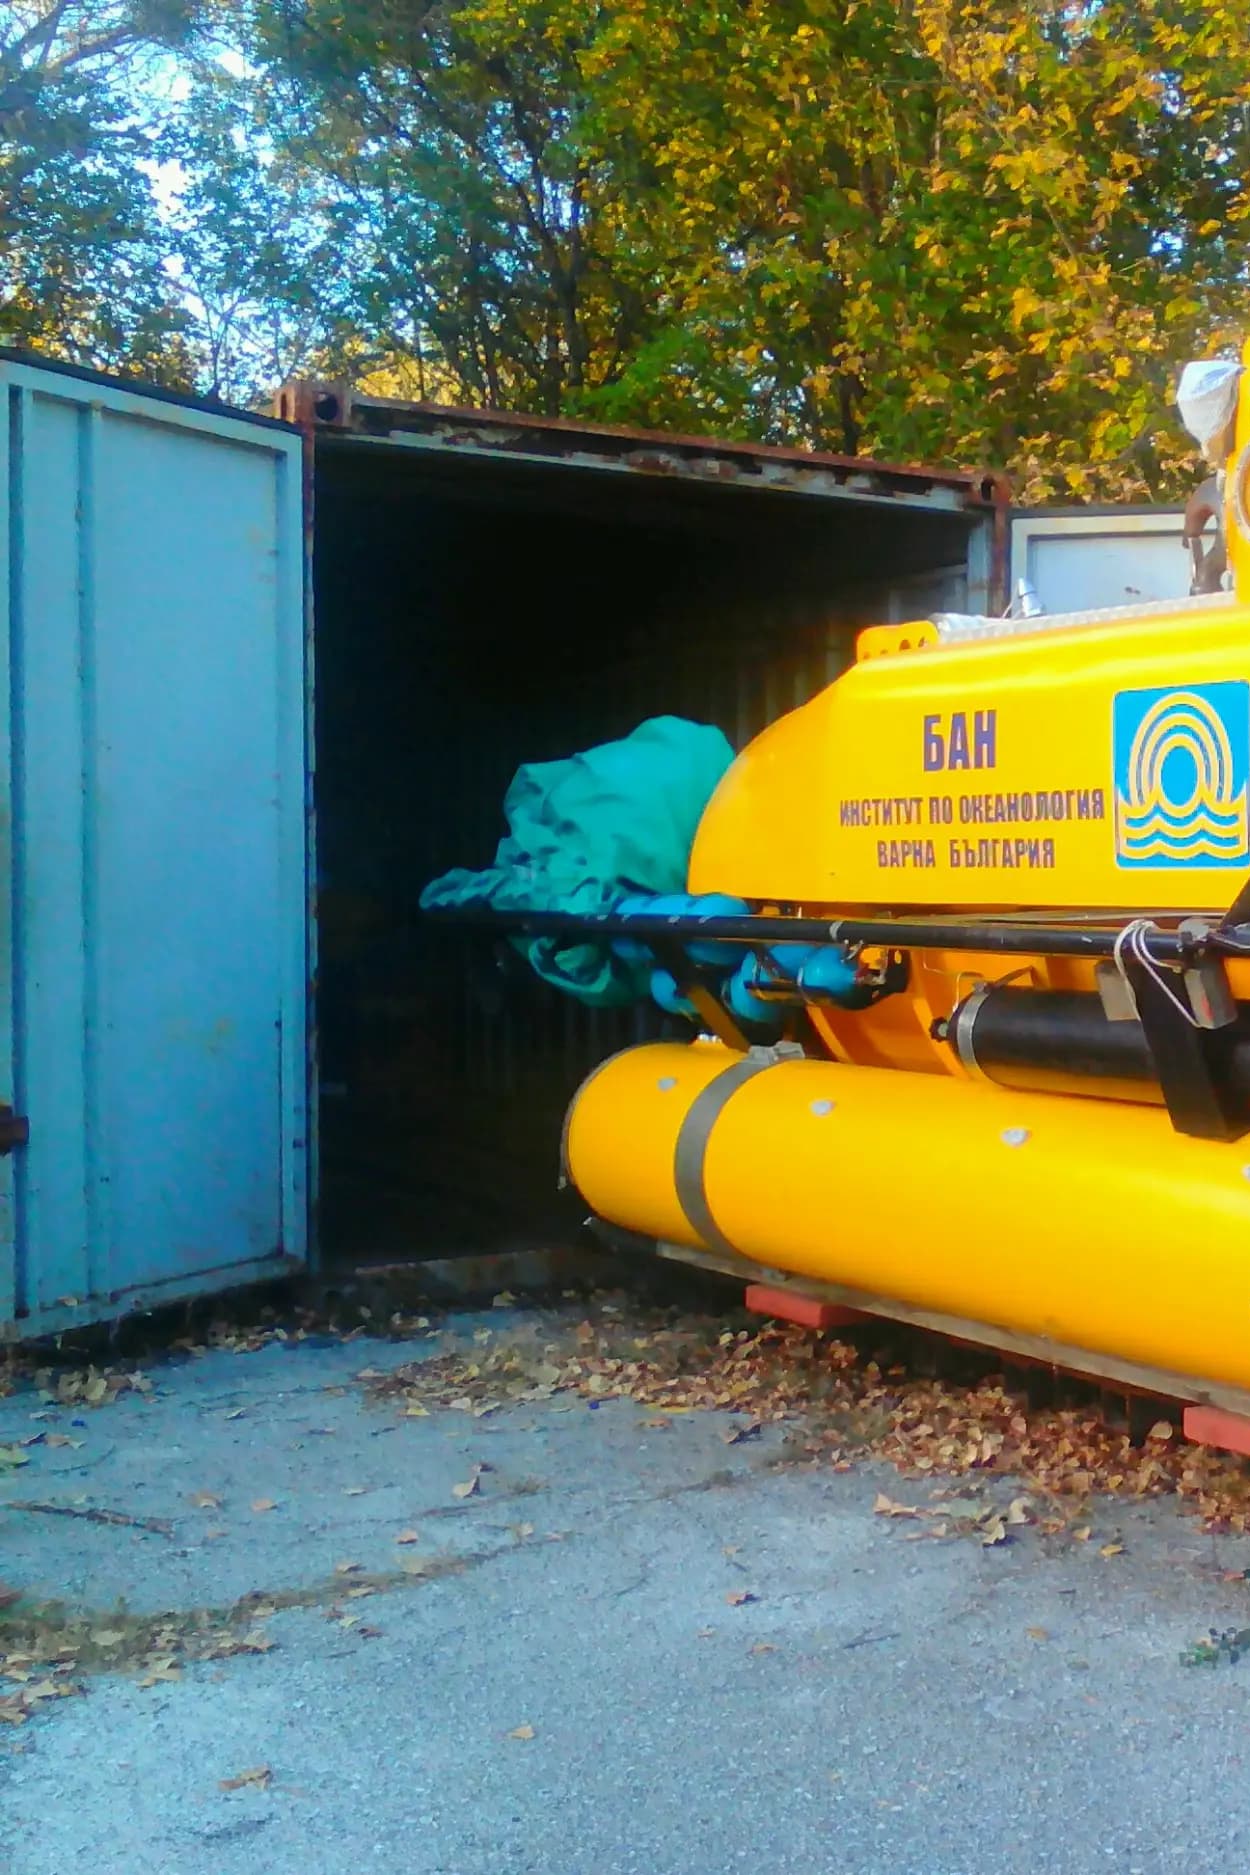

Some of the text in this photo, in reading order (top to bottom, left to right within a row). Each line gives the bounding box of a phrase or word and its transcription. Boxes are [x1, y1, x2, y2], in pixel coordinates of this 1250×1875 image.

[923, 709, 997, 772] БАН
[840, 788, 1105, 827] ИНСТИТУТ ПО ОКЕАНОЛОГИЯ
[877, 838, 1055, 868] ВАРНА БЪЛГАРИЯ
